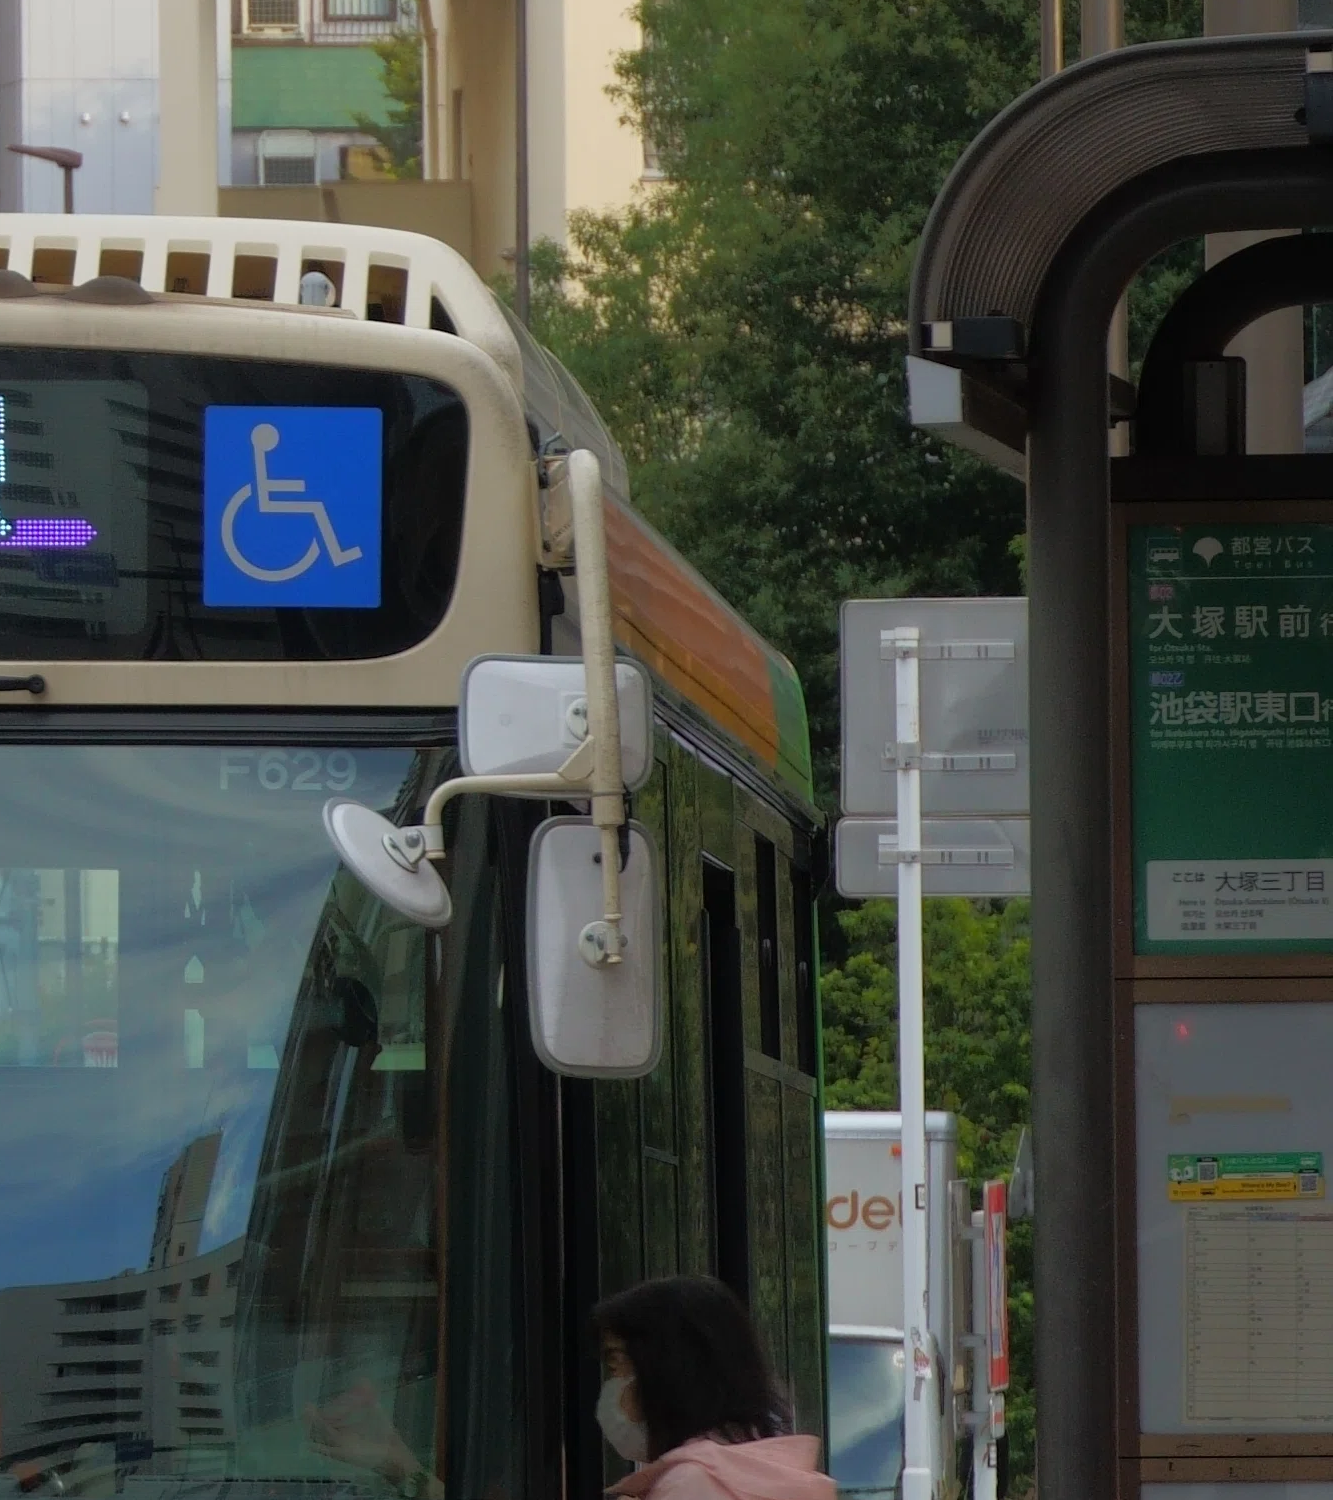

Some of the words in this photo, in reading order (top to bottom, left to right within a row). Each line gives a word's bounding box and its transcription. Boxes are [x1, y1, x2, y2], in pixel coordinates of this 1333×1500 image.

[1230, 535, 1317, 556] 都営バス
[219, 749, 358, 793] F629
[1172, 872, 1206, 883] ここは
[1215, 870, 1325, 892] 大塚三丁目
